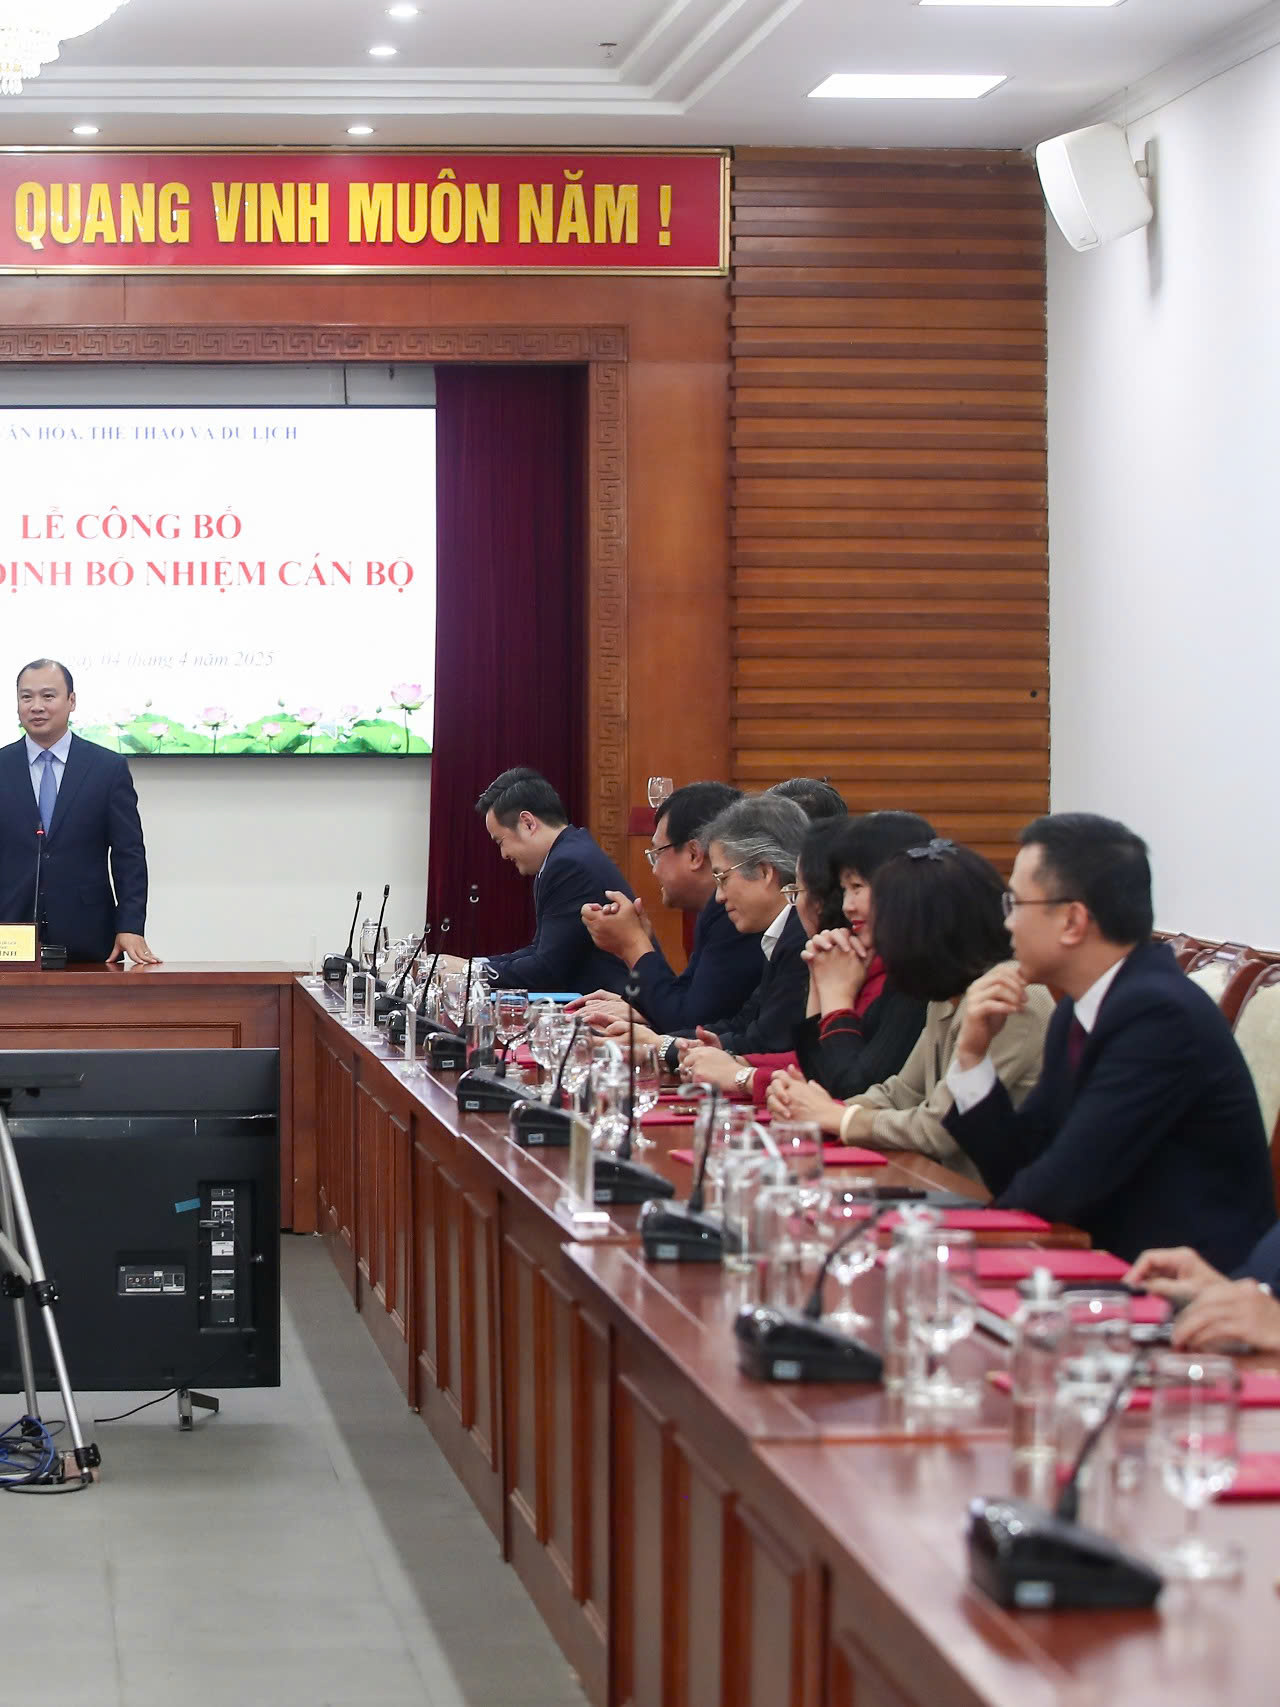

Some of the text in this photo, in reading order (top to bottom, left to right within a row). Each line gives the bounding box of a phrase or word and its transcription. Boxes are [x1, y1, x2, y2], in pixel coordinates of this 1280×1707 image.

[15, 182, 190, 249] QUANG
[212, 182, 329, 244] VINH
[349, 168, 500, 244] MUÔN
[519, 170, 639, 244] NĂM
[658, 184, 672, 246] !
[133, 426, 185, 440] THAO
[21, 505, 242, 540] LỄ CÔNG BỐ
[145, 556, 267, 594] NHIỆM
[278, 552, 353, 587] CÁN
[365, 556, 415, 594] BỘ
[232, 651, 277, 667] 2025
